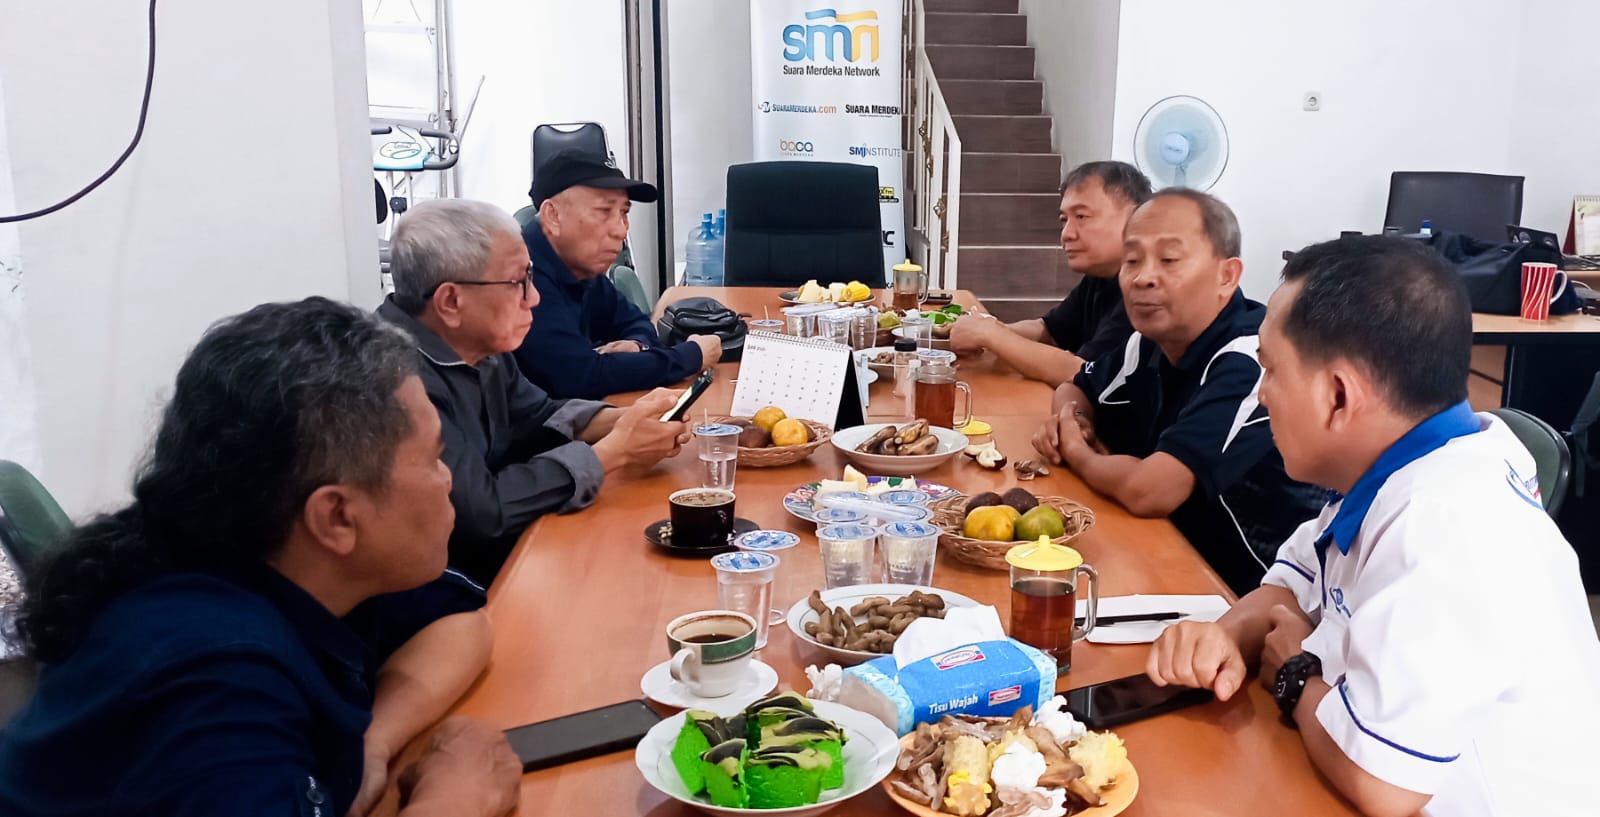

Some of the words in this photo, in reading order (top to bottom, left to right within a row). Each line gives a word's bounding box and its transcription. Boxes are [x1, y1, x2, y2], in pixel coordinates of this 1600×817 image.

[783, 65, 804, 75] Suara
[806, 65, 842, 76] Merdeka
[844, 66, 880, 77] Network
[845, 104, 870, 114] SUARA
[929, 703, 948, 714] Tisu
[949, 694, 978, 710] Wajah
